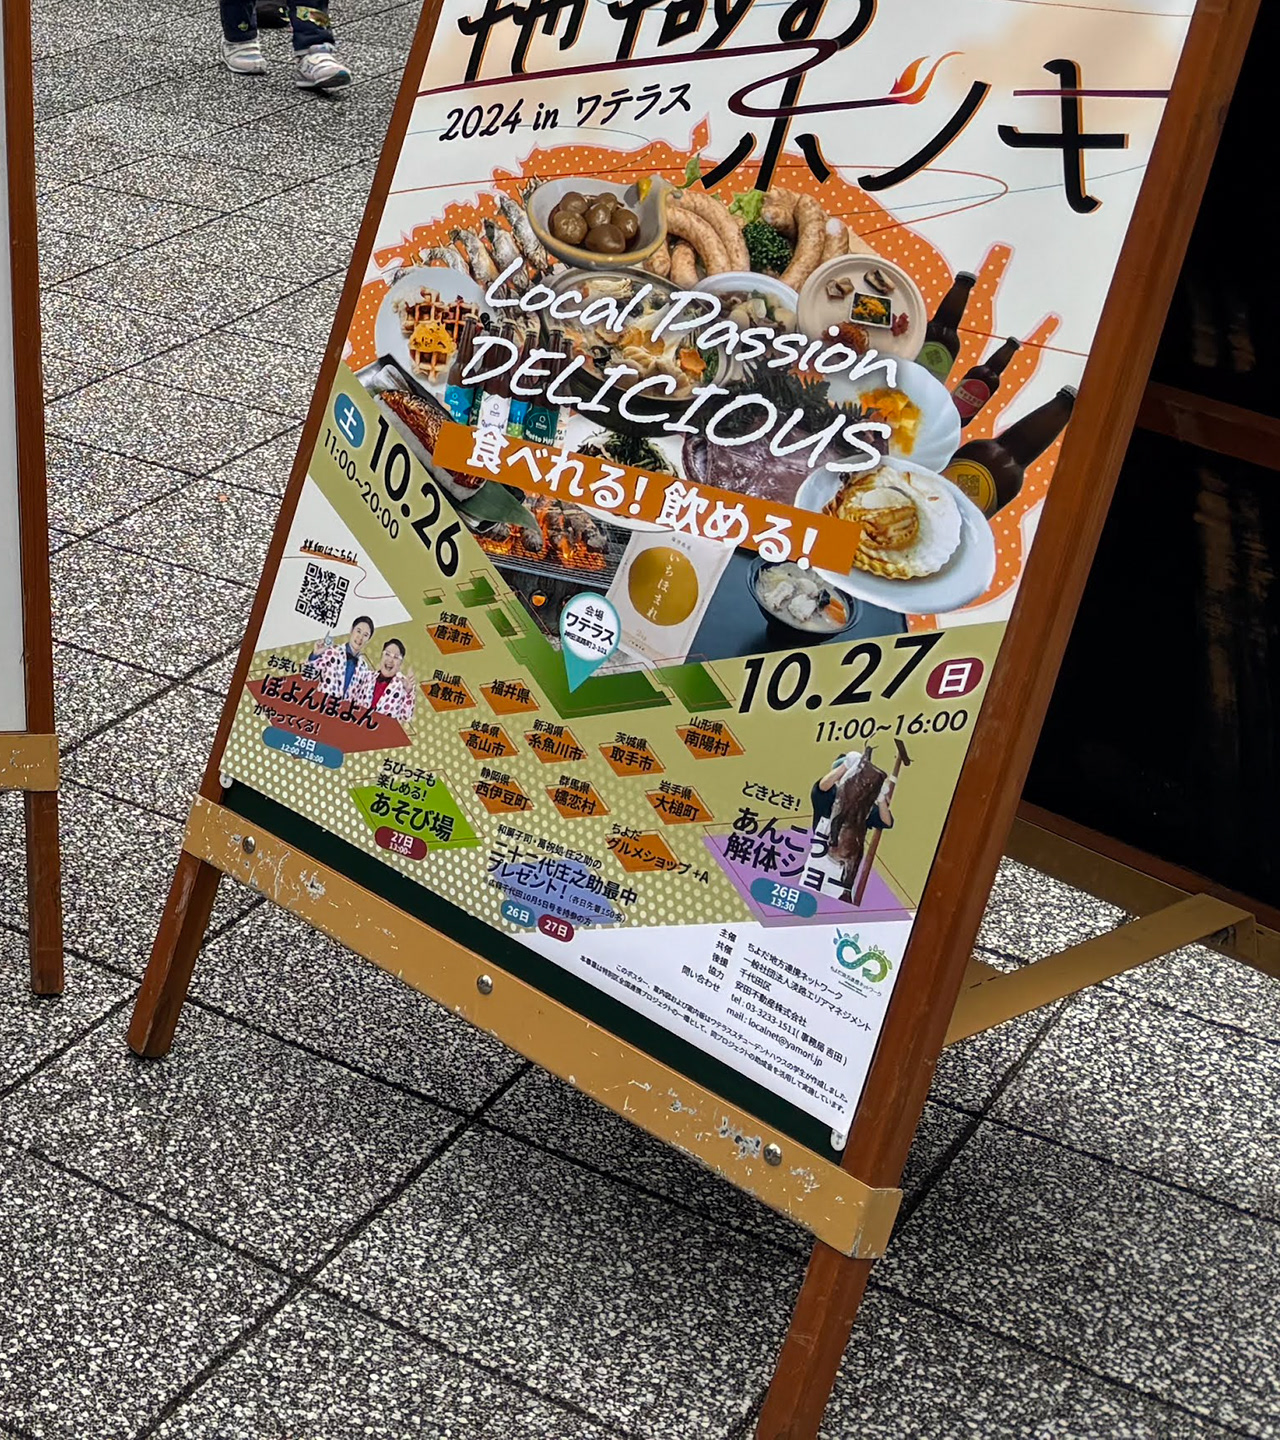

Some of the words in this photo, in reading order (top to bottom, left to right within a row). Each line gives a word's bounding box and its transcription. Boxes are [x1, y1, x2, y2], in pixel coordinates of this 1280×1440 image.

[439, 98, 524, 141] 2024
[532, 102, 560, 129] in
[577, 83, 691, 127] ワテラス
[486, 256, 654, 332] Local
[650, 292, 900, 390] Passion
[461, 333, 892, 474] DELICIOUS
[340, 406, 357, 440] 土
[369, 414, 461, 577] 10.26
[646, 553, 680, 621] いちほまれ
[440, 610, 468, 629] 佐賀県
[584, 605, 605, 621] 会場
[433, 624, 475, 648] 唐津市
[565, 611, 615, 646] ワテラス
[267, 654, 324, 682] お笑い芸人
[433, 669, 461, 687] 岡山県
[738, 632, 946, 714] 10.27
[939, 662, 972, 695] 日
[426, 682, 467, 705] 倉敷市
[490, 679, 531, 705] 福井県
[471, 720, 501, 739] 岐阜県
[533, 718, 564, 738] 新潟県
[690, 716, 723, 736] 山形県
[294, 736, 317, 751] 26日
[465, 733, 507, 758] 高山市
[528, 732, 583, 762] 糸魚川市
[615, 731, 648, 751] 茨城県
[684, 730, 731, 756] 南陽村
[382, 757, 437, 787] ちびっ子も
[609, 746, 653, 772] 取手市
[480, 766, 511, 786] 静岡県
[558, 775, 591, 795] 群馬県
[658, 779, 693, 799] 岩手県
[474, 781, 531, 811] 西伊豆町
[553, 788, 597, 815] 嬬恋村
[653, 796, 700, 822] 大槌町
[369, 791, 455, 842] あそび場
[391, 831, 414, 849] 27日
[612, 823, 641, 843] ちよだ
[732, 806, 831, 859] あんこう
[605, 836, 692, 877] グルメショップ
[722, 833, 844, 892] 解体ショー
[489, 841, 639, 907] 二十二代庄之助最中
[770, 883, 800, 902] 26日
[770, 897, 796, 913] 13:30
[507, 904, 530, 924] 26日
[544, 919, 569, 938] 27日
[719, 929, 737, 943] 主催
[681, 966, 721, 992] 問い合わせ
[708, 965, 725, 980] 協力
[740, 968, 772, 992] 千代田区
